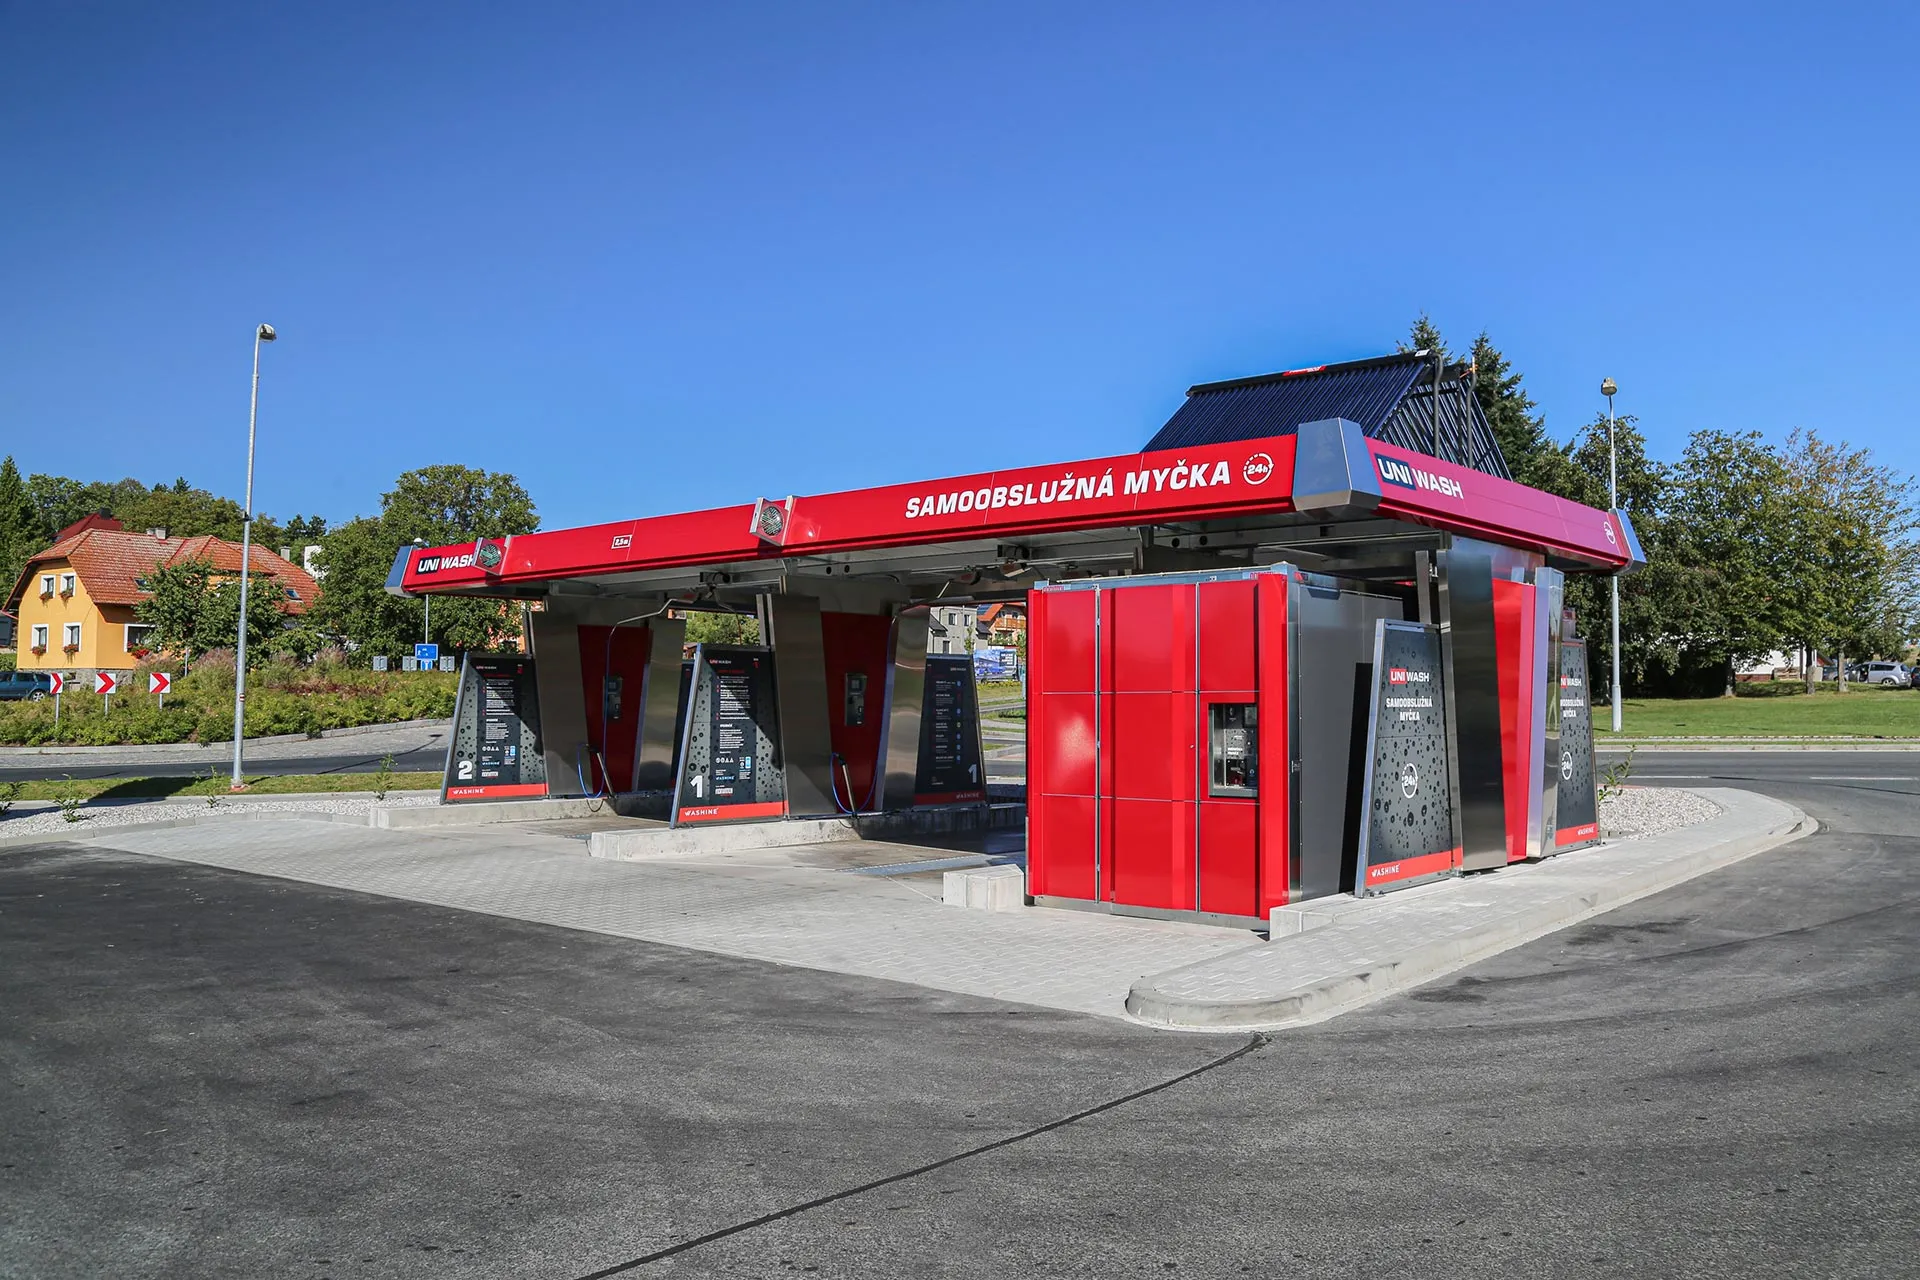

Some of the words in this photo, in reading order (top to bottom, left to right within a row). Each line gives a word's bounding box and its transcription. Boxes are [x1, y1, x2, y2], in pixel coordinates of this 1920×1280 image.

[1247, 463, 1269, 475] 24h
[1377, 458, 1413, 485] UNI
[1411, 467, 1464, 500] WASH
[905, 468, 1114, 518] SAMOOBSLUŽNÁ
[1123, 459, 1231, 494] MYČKA
[417, 558, 440, 573] UNI
[1390, 671, 1406, 682] UNI
[1406, 671, 1430, 683] WASH
[1567, 677, 1582, 687] WASH
[1386, 695, 1433, 708] SAMOOBSLUŽNÁ
[1399, 708, 1421, 721] MYČKA
[458, 760, 473, 780] 2
[968, 763, 978, 783] 1
[453, 787, 485, 795] WASHINE
[690, 775, 703, 798] 1
[684, 807, 719, 816] WASHINE
[1371, 863, 1400, 877] WASHINE
